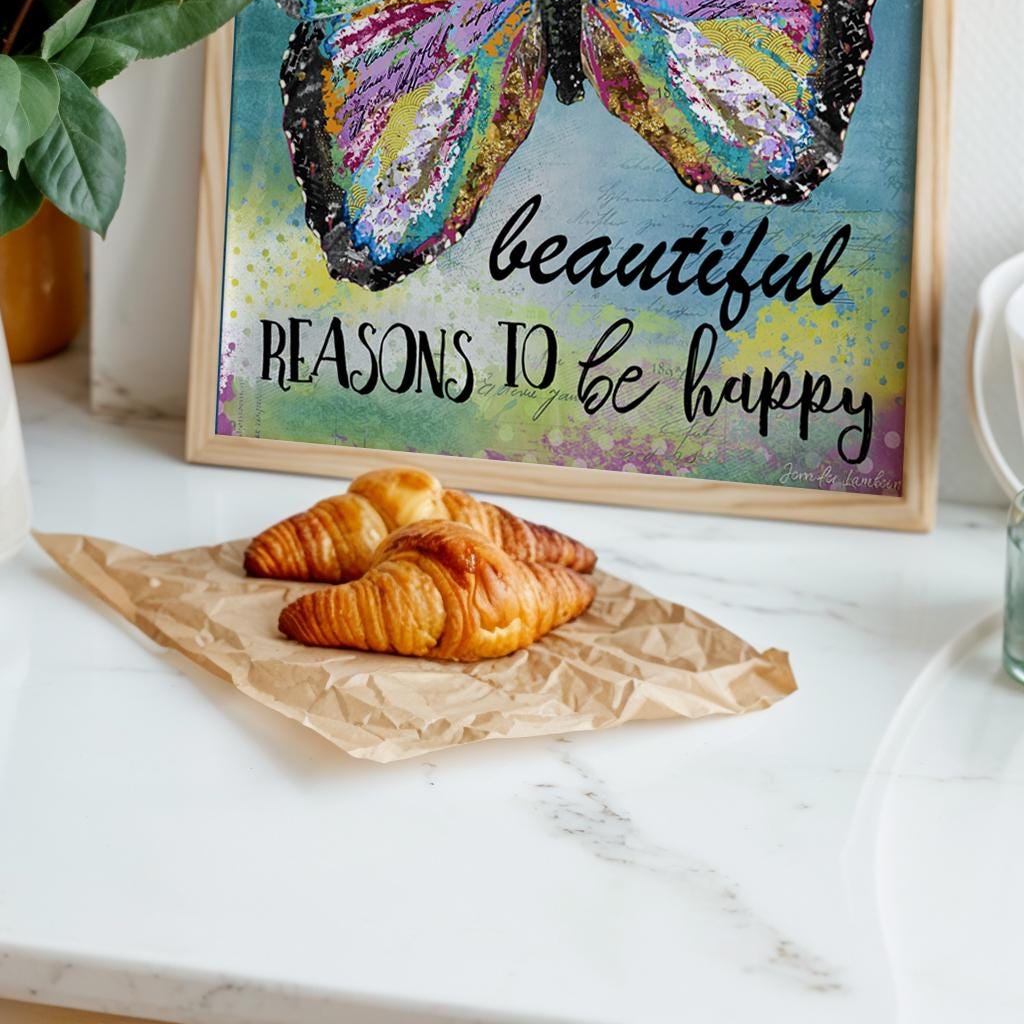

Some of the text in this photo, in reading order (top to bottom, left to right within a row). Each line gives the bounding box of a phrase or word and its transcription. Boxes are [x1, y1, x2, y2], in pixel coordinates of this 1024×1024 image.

[490, 194, 853, 331] beautiful
[260, 317, 473, 404] REASONS
[498, 320, 558, 390] TO
[578, 318, 660, 416] be
[683, 322, 874, 465] happy
